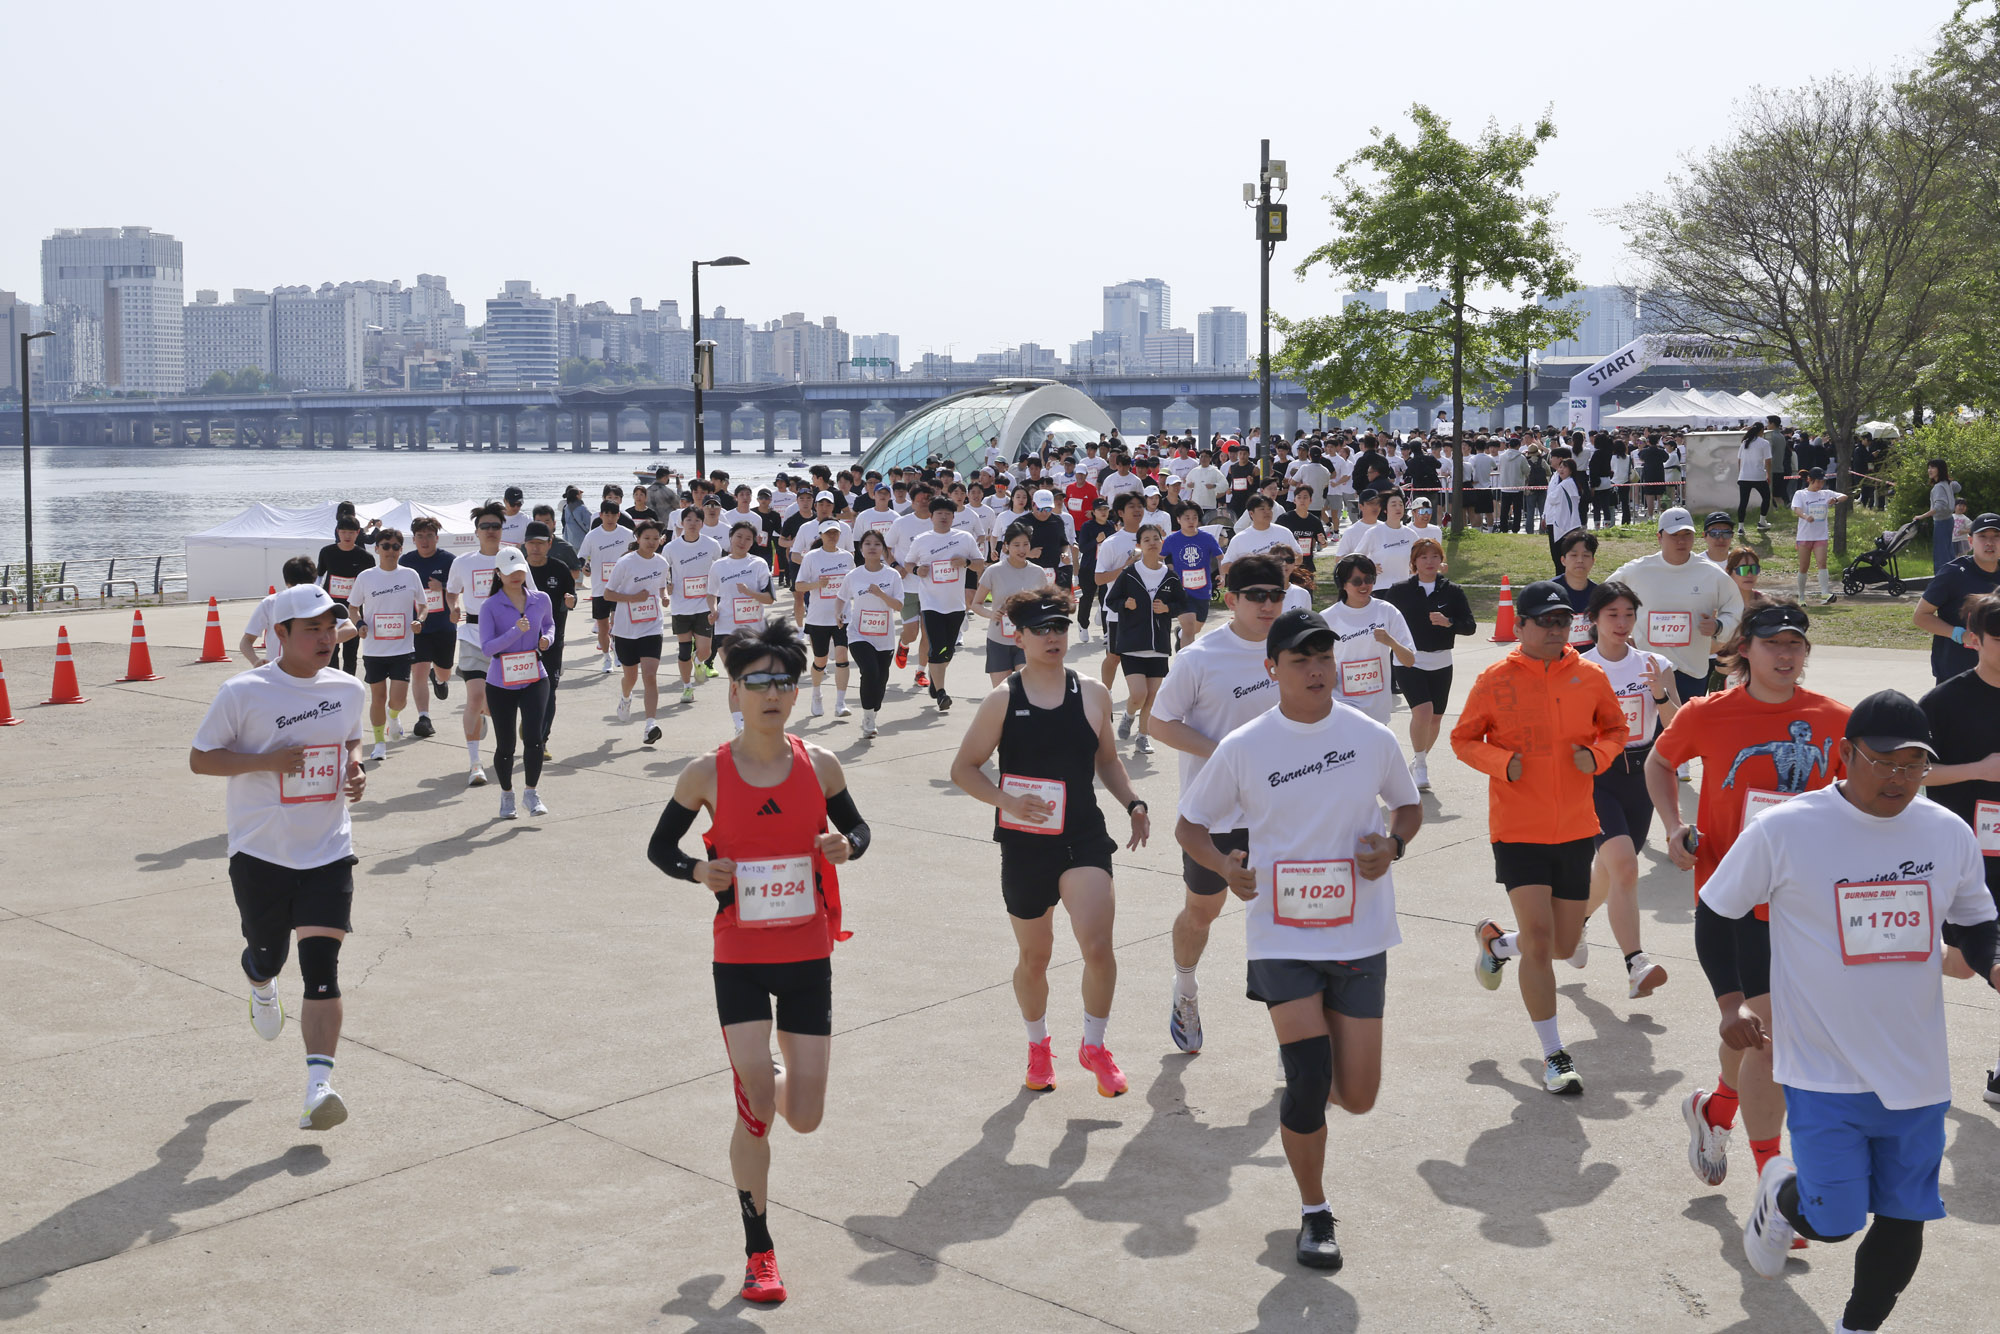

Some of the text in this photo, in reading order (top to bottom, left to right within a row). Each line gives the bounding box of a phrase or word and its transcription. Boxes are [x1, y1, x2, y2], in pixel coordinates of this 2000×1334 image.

[1587, 349, 1637, 387] START
[680, 556, 698, 566] Burning
[633, 573, 653, 583] Burning
[720, 573, 741, 584] Burning
[371, 584, 406, 597] Burning Run
[637, 604, 654, 612] 3013
[742, 605, 760, 613] 3017
[383, 622, 402, 630] 1023
[867, 619, 885, 627] 3016
[1340, 622, 1385, 642] Burning Run
[1573, 624, 1591, 633] 230
[1660, 624, 1686, 633] 1707
[512, 662, 534, 672] 3307
[1354, 671, 1378, 682] 3730
[1232, 678, 1270, 699] Burning
[275, 708, 319, 729] Burning
[318, 700, 342, 715] Run
[1624, 712, 1637, 722] 43
[300, 765, 335, 779] 1145
[1268, 761, 1324, 788] Burning
[1323, 749, 1356, 768] Run
[1007, 780, 1030, 789] BURNING
[1981, 823, 1990, 831] M
[741, 865, 766, 874] A-132
[1898, 860, 1934, 879] Run
[744, 879, 806, 898] M 1924
[1283, 884, 1346, 899] M 1020
[1844, 890, 1878, 900] BURNING
[1880, 890, 1897, 898] RUN
[1850, 910, 1921, 929] M 1703
